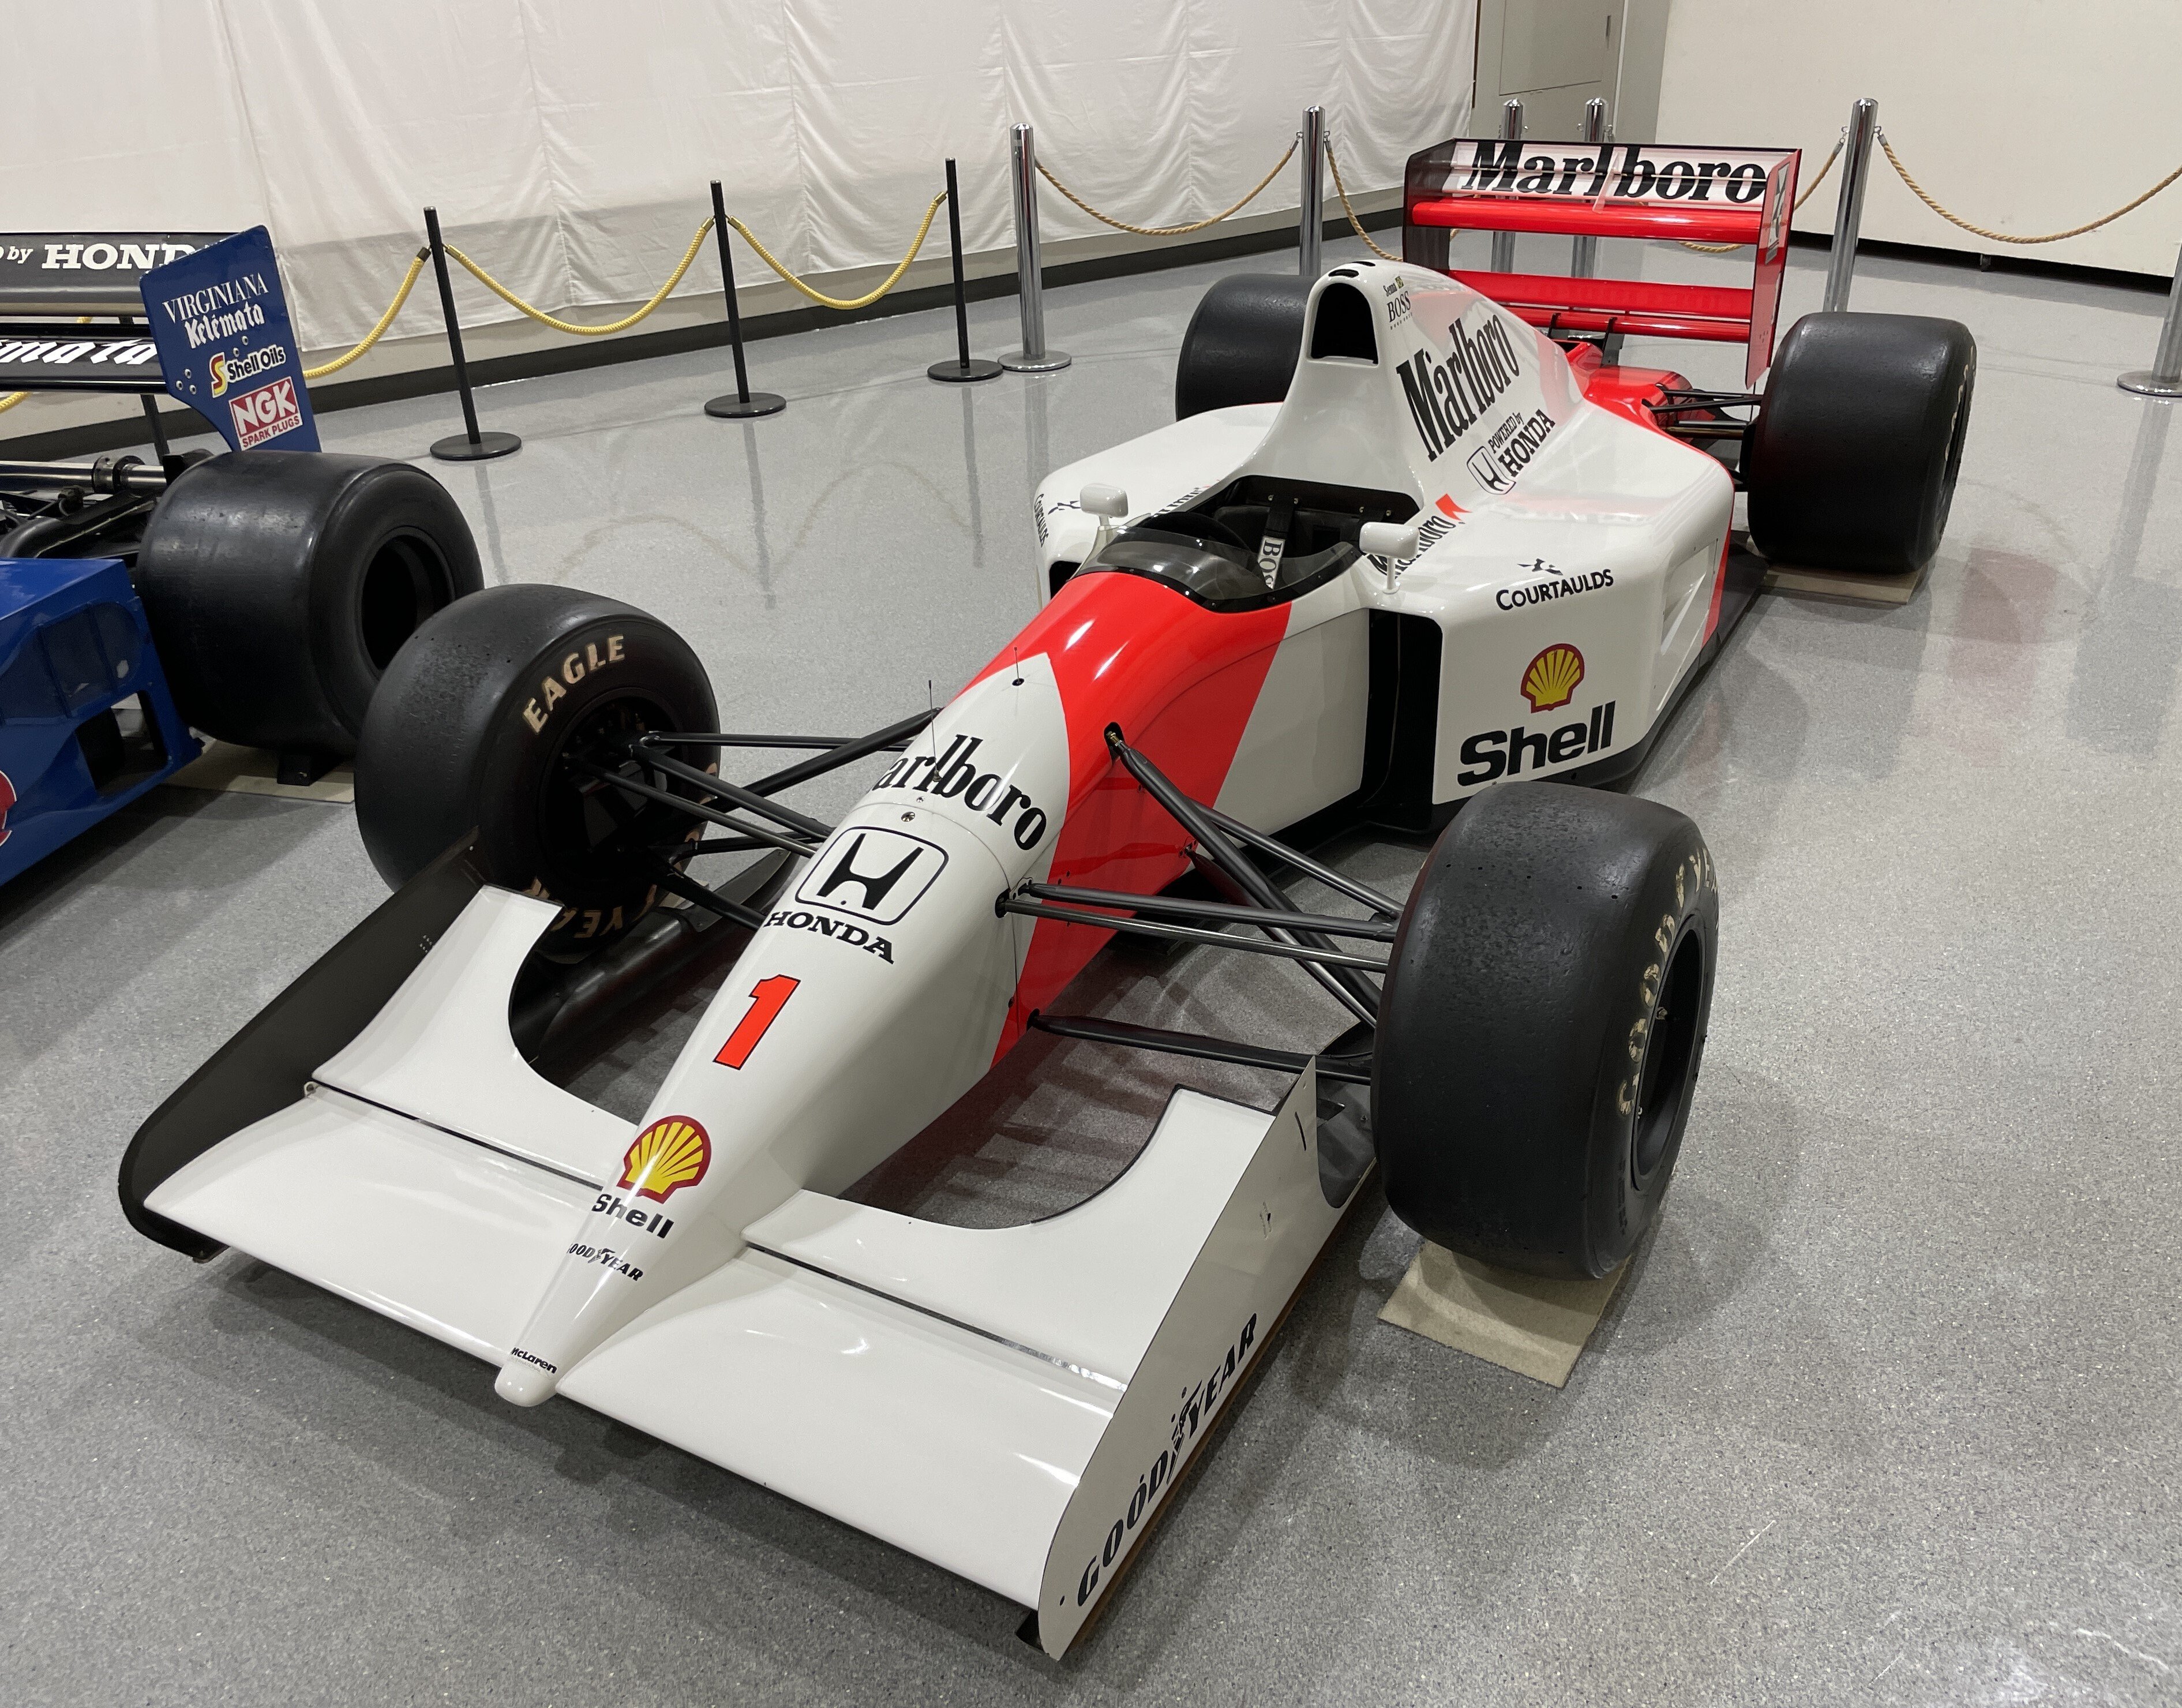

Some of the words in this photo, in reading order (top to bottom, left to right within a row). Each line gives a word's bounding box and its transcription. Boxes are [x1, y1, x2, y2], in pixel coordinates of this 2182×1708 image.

[1461, 141, 1767, 203] Marlboro
[7, 246, 33, 264] by
[42, 243, 209, 269] HOND
[162, 272, 269, 324] VIRGINIANA
[1386, 290, 1411, 323] BOSS
[227, 354, 260, 381] Shell
[260, 346, 286, 368] Oils
[1395, 314, 1520, 462] Marlboro
[232, 380, 297, 434] NGK
[242, 430, 271, 448] SPARK
[272, 415, 301, 435] PLUGS
[1488, 415, 1518, 454] POWERED
[1512, 411, 1525, 425] by
[1497, 409, 1556, 478] HONDA
[1495, 568, 1614, 611] COURTAULDS
[522, 635, 626, 735] EAGLE
[1457, 699, 1617, 786] Shell
[872, 734, 1047, 851] arlboro
[763, 911, 895, 965] HONDA
[713, 973, 801, 1070] 1
[591, 1193, 674, 1239] Shell
[567, 1243, 644, 1282] OODYEAR
[511, 1347, 558, 1374] McLaren
[1077, 1313, 1257, 1608] GOODYEAR
